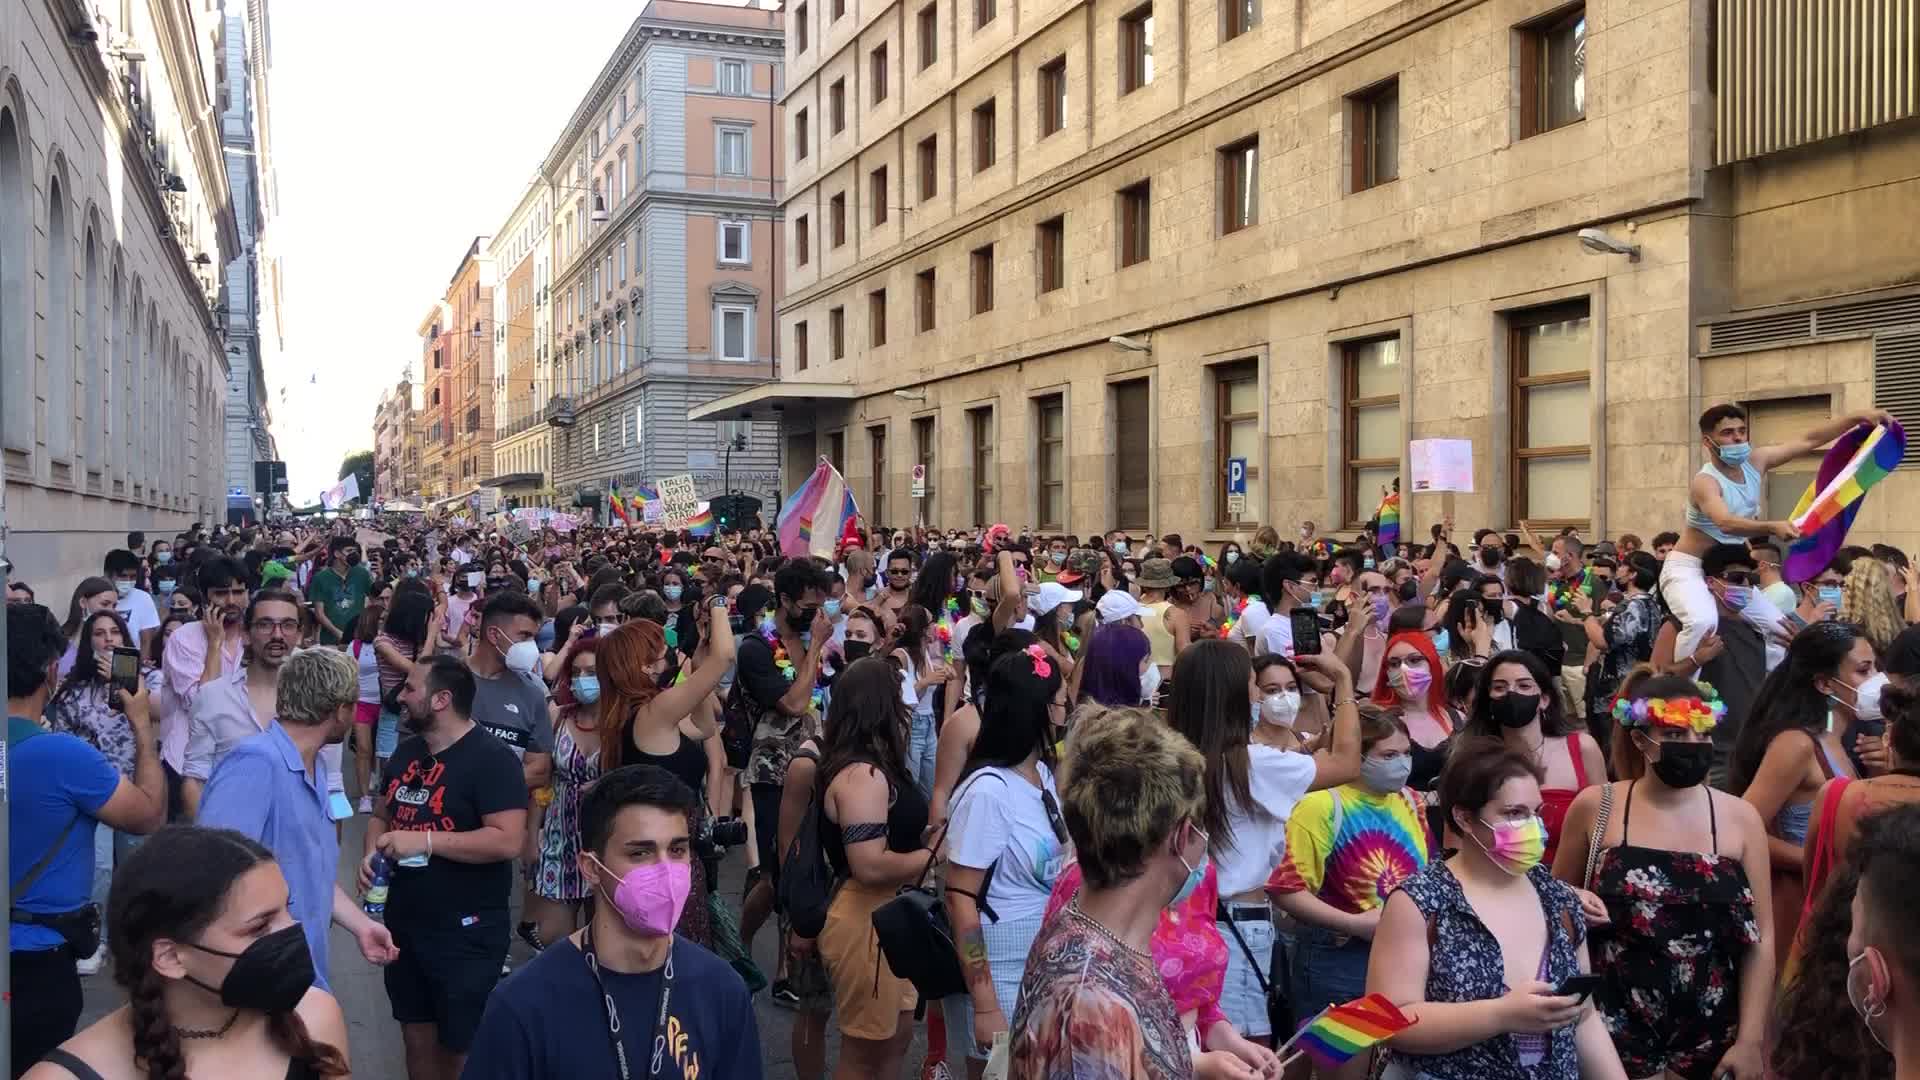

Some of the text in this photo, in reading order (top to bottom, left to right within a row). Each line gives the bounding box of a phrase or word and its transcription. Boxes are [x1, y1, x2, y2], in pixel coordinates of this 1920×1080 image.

[660, 476, 690, 489] ITALIA
[1231, 461, 1242, 491] P
[665, 484, 692, 497] STATO
[664, 493, 694, 505] LAICO
[667, 509, 695, 520] STATO
[495, 728, 519, 741] FACE
